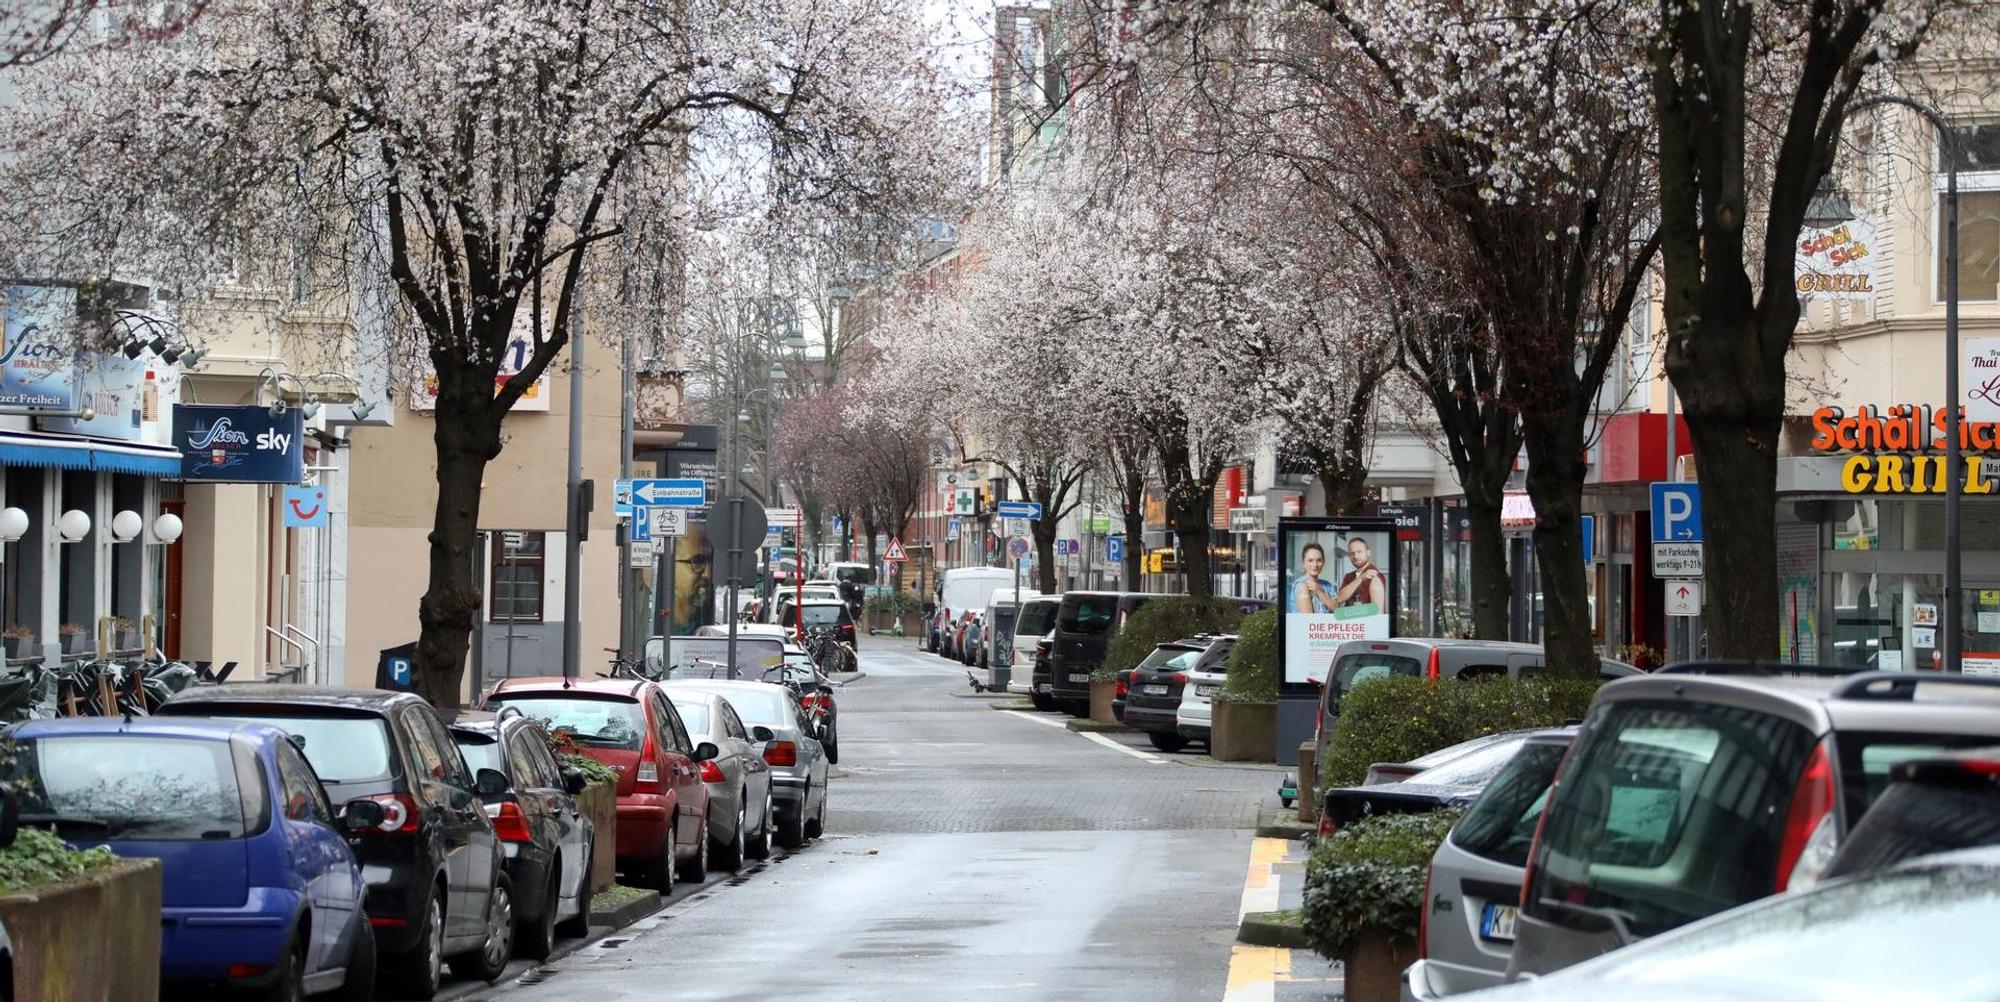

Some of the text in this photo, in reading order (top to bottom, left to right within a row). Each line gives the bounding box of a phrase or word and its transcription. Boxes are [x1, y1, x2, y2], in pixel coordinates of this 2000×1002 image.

[1830, 241, 1869, 267] Sick
[1797, 273, 1873, 292] GRILL
[1971, 356, 1998, 368] Thai
[20, 394, 61, 405] Freiheit
[188, 416, 249, 449] Sion
[1811, 404, 1921, 450] Schäl
[256, 427, 291, 455] sky
[653, 489, 700, 497] Einbahnstraße
[1664, 492, 1692, 540] P
[1110, 541, 1118, 560] P
[1657, 547, 1699, 556] mit Parkschein
[1656, 560, 1682, 571] werktags
[1309, 623, 1366, 631] DIE PFLEGE
[394, 661, 407, 680] P
[1492, 909, 1505, 933] K
